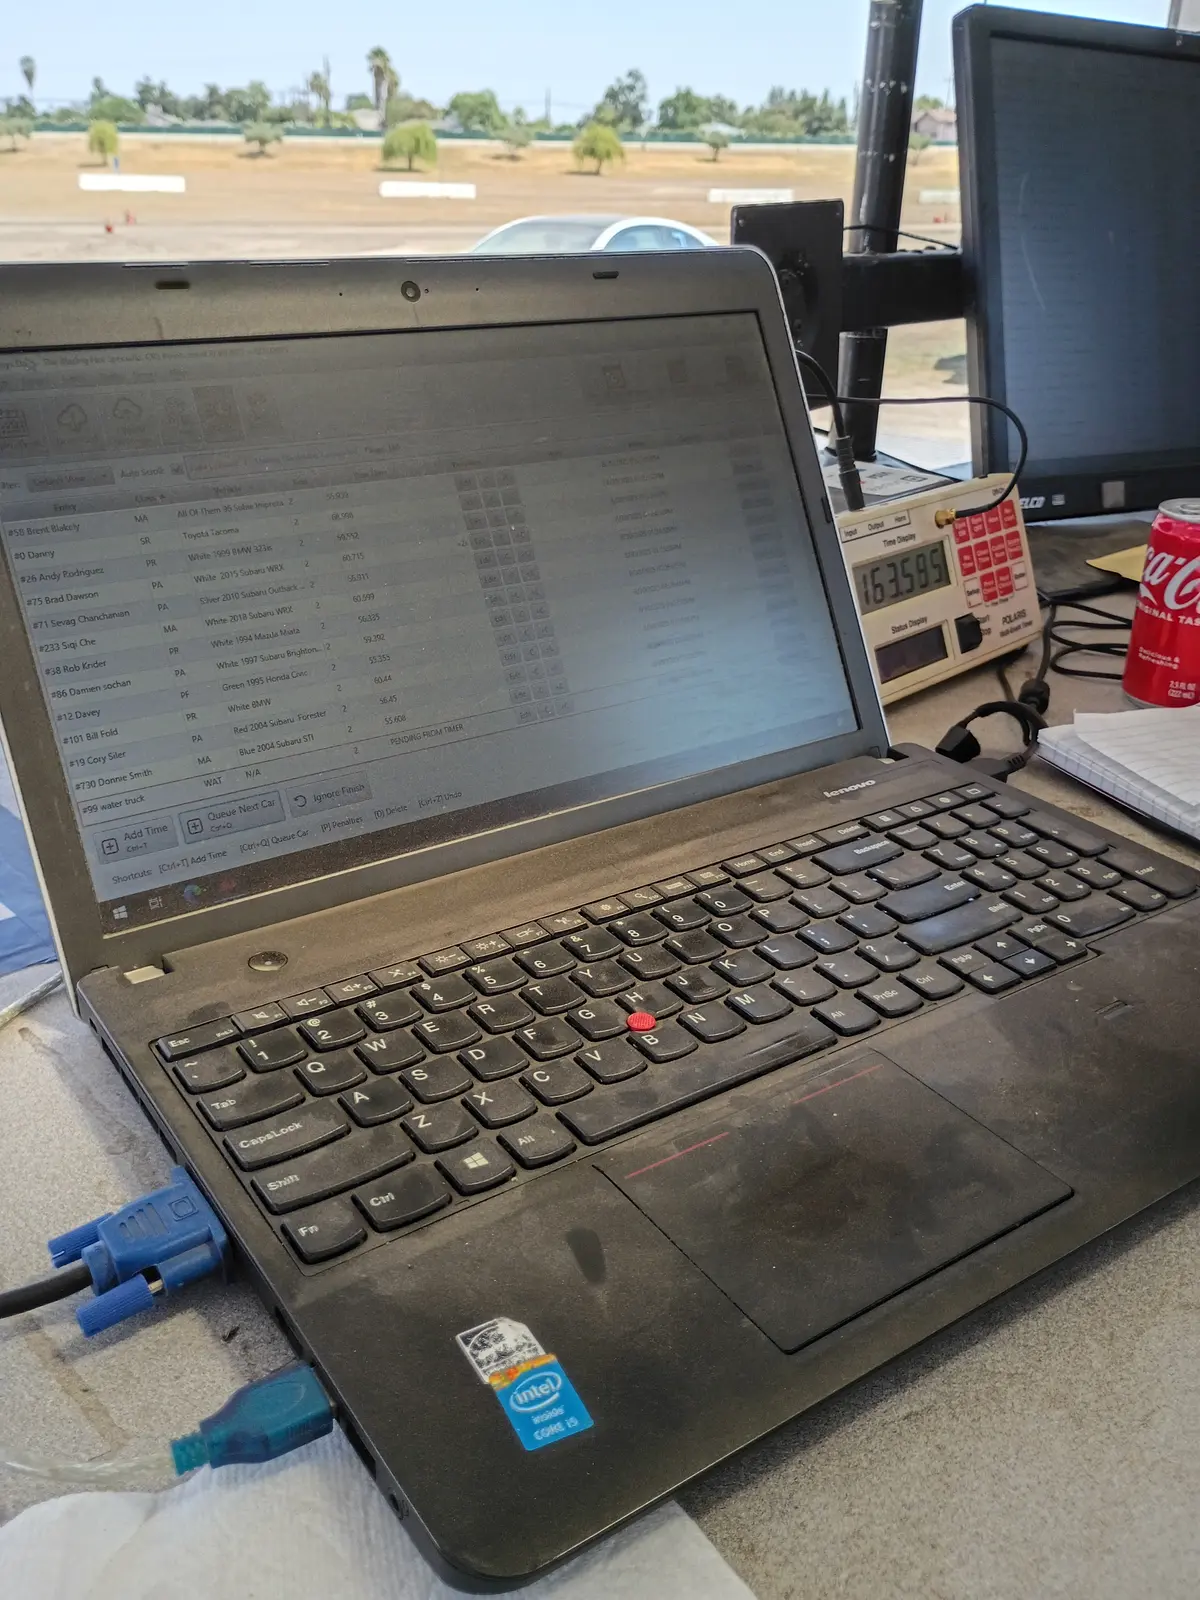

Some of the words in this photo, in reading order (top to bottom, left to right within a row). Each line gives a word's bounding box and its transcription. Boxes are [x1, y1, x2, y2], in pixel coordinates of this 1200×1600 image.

[134, 515, 148, 523] MA
[867, 521, 884, 531] Output
[182, 531, 209, 541] Toyota
[211, 527, 239, 537] Tacoma
[882, 539, 896, 547] Time
[897, 533, 916, 544] Display
[28, 550, 55, 560] Danny
[188, 552, 211, 562] White
[145, 559, 157, 567] PR
[20, 575, 37, 583] #26
[39, 573, 61, 582] Andy
[193, 574, 216, 584] White
[220, 569, 239, 580] 2015
[240, 567, 265, 577] Subaru
[266, 563, 284, 573] WRX
[151, 581, 163, 589] PA
[27, 598, 43, 606] #75
[44, 596, 64, 605] Brad
[66, 591, 99, 602] Dawson
[199, 595, 221, 605] Silver
[222, 592, 240, 602] 2010
[241, 588, 267, 598] Subaru
[157, 603, 170, 611] PA
[205, 617, 228, 627] White
[229, 613, 247, 623] 2018
[248, 610, 274, 620] Subaru
[275, 605, 293, 615] WRX
[33, 621, 49, 630] #71
[51, 619, 76, 628] Sevag
[163, 625, 178, 633] MA
[891, 623, 908, 634] Status
[909, 617, 927, 630] Display
[210, 638, 234, 648] White
[235, 634, 253, 644] 1994
[39, 644, 60, 653] #233
[168, 647, 179, 655] PR
[216, 660, 240, 670] White
[241, 656, 258, 665] 1997
[259, 652, 285, 662] Subaru
[45, 667, 61, 676] #38
[63, 665, 80, 673] Rob
[174, 669, 186, 677] PA
[222, 682, 244, 692] Green
[246, 678, 264, 688] 1995
[266, 674, 290, 685] Honda
[51, 690, 67, 698] #86
[69, 686, 101, 697] Damien
[228, 703, 250, 713] White
[252, 697, 272, 709] BMW
[57, 713, 73, 721] #12
[75, 709, 100, 719] Davey
[186, 713, 197, 721] PR
[233, 726, 248, 735] Red
[250, 722, 268, 732] 2004
[269, 716, 295, 729] Subaru
[298, 710, 327, 723] Forester
[63, 735, 83, 744] #101
[86, 732, 98, 741] Bill
[100, 728, 119, 739] Fold
[192, 735, 204, 743] PA
[389, 732, 421, 745] PENDING
[422, 728, 443, 739] FROM
[444, 723, 464, 734] TIMER
[239, 747, 256, 757] Blue
[257, 742, 275, 753] 2004
[276, 737, 302, 750] Subaru
[69, 758, 86, 767] #19
[87, 756, 107, 765] Cory
[197, 756, 212, 765] MA
[75, 780, 96, 790] #730
[129, 769, 153, 780] Smith
[245, 769, 261, 780] N/A
[313, 792, 340, 805] Ignore
[342, 784, 364, 797] Finish
[823, 780, 876, 798] lenovo
[83, 805, 98, 814] #99
[100, 800, 123, 810] water
[125, 795, 145, 806] truck
[208, 808, 237, 822] Queue
[239, 802, 259, 814] Next
[260, 799, 276, 810] Car
[124, 828, 143, 841] Add
[145, 824, 168, 837] Time
[190, 854, 206, 864] Add
[208, 849, 228, 861] Time
[916, 975, 934, 984] Ctrl
[831, 1010, 845, 1019] Alt
[168, 1038, 190, 1047] Esc
[211, 1099, 236, 1109] Tab
[239, 1122, 303, 1148] CapsLock
[518, 1135, 535, 1146] Alt
[267, 1175, 300, 1191] Shift
[370, 1192, 395, 1206] Ctrl
[298, 1225, 318, 1237] Fn
[515, 1378, 556, 1405] intel
